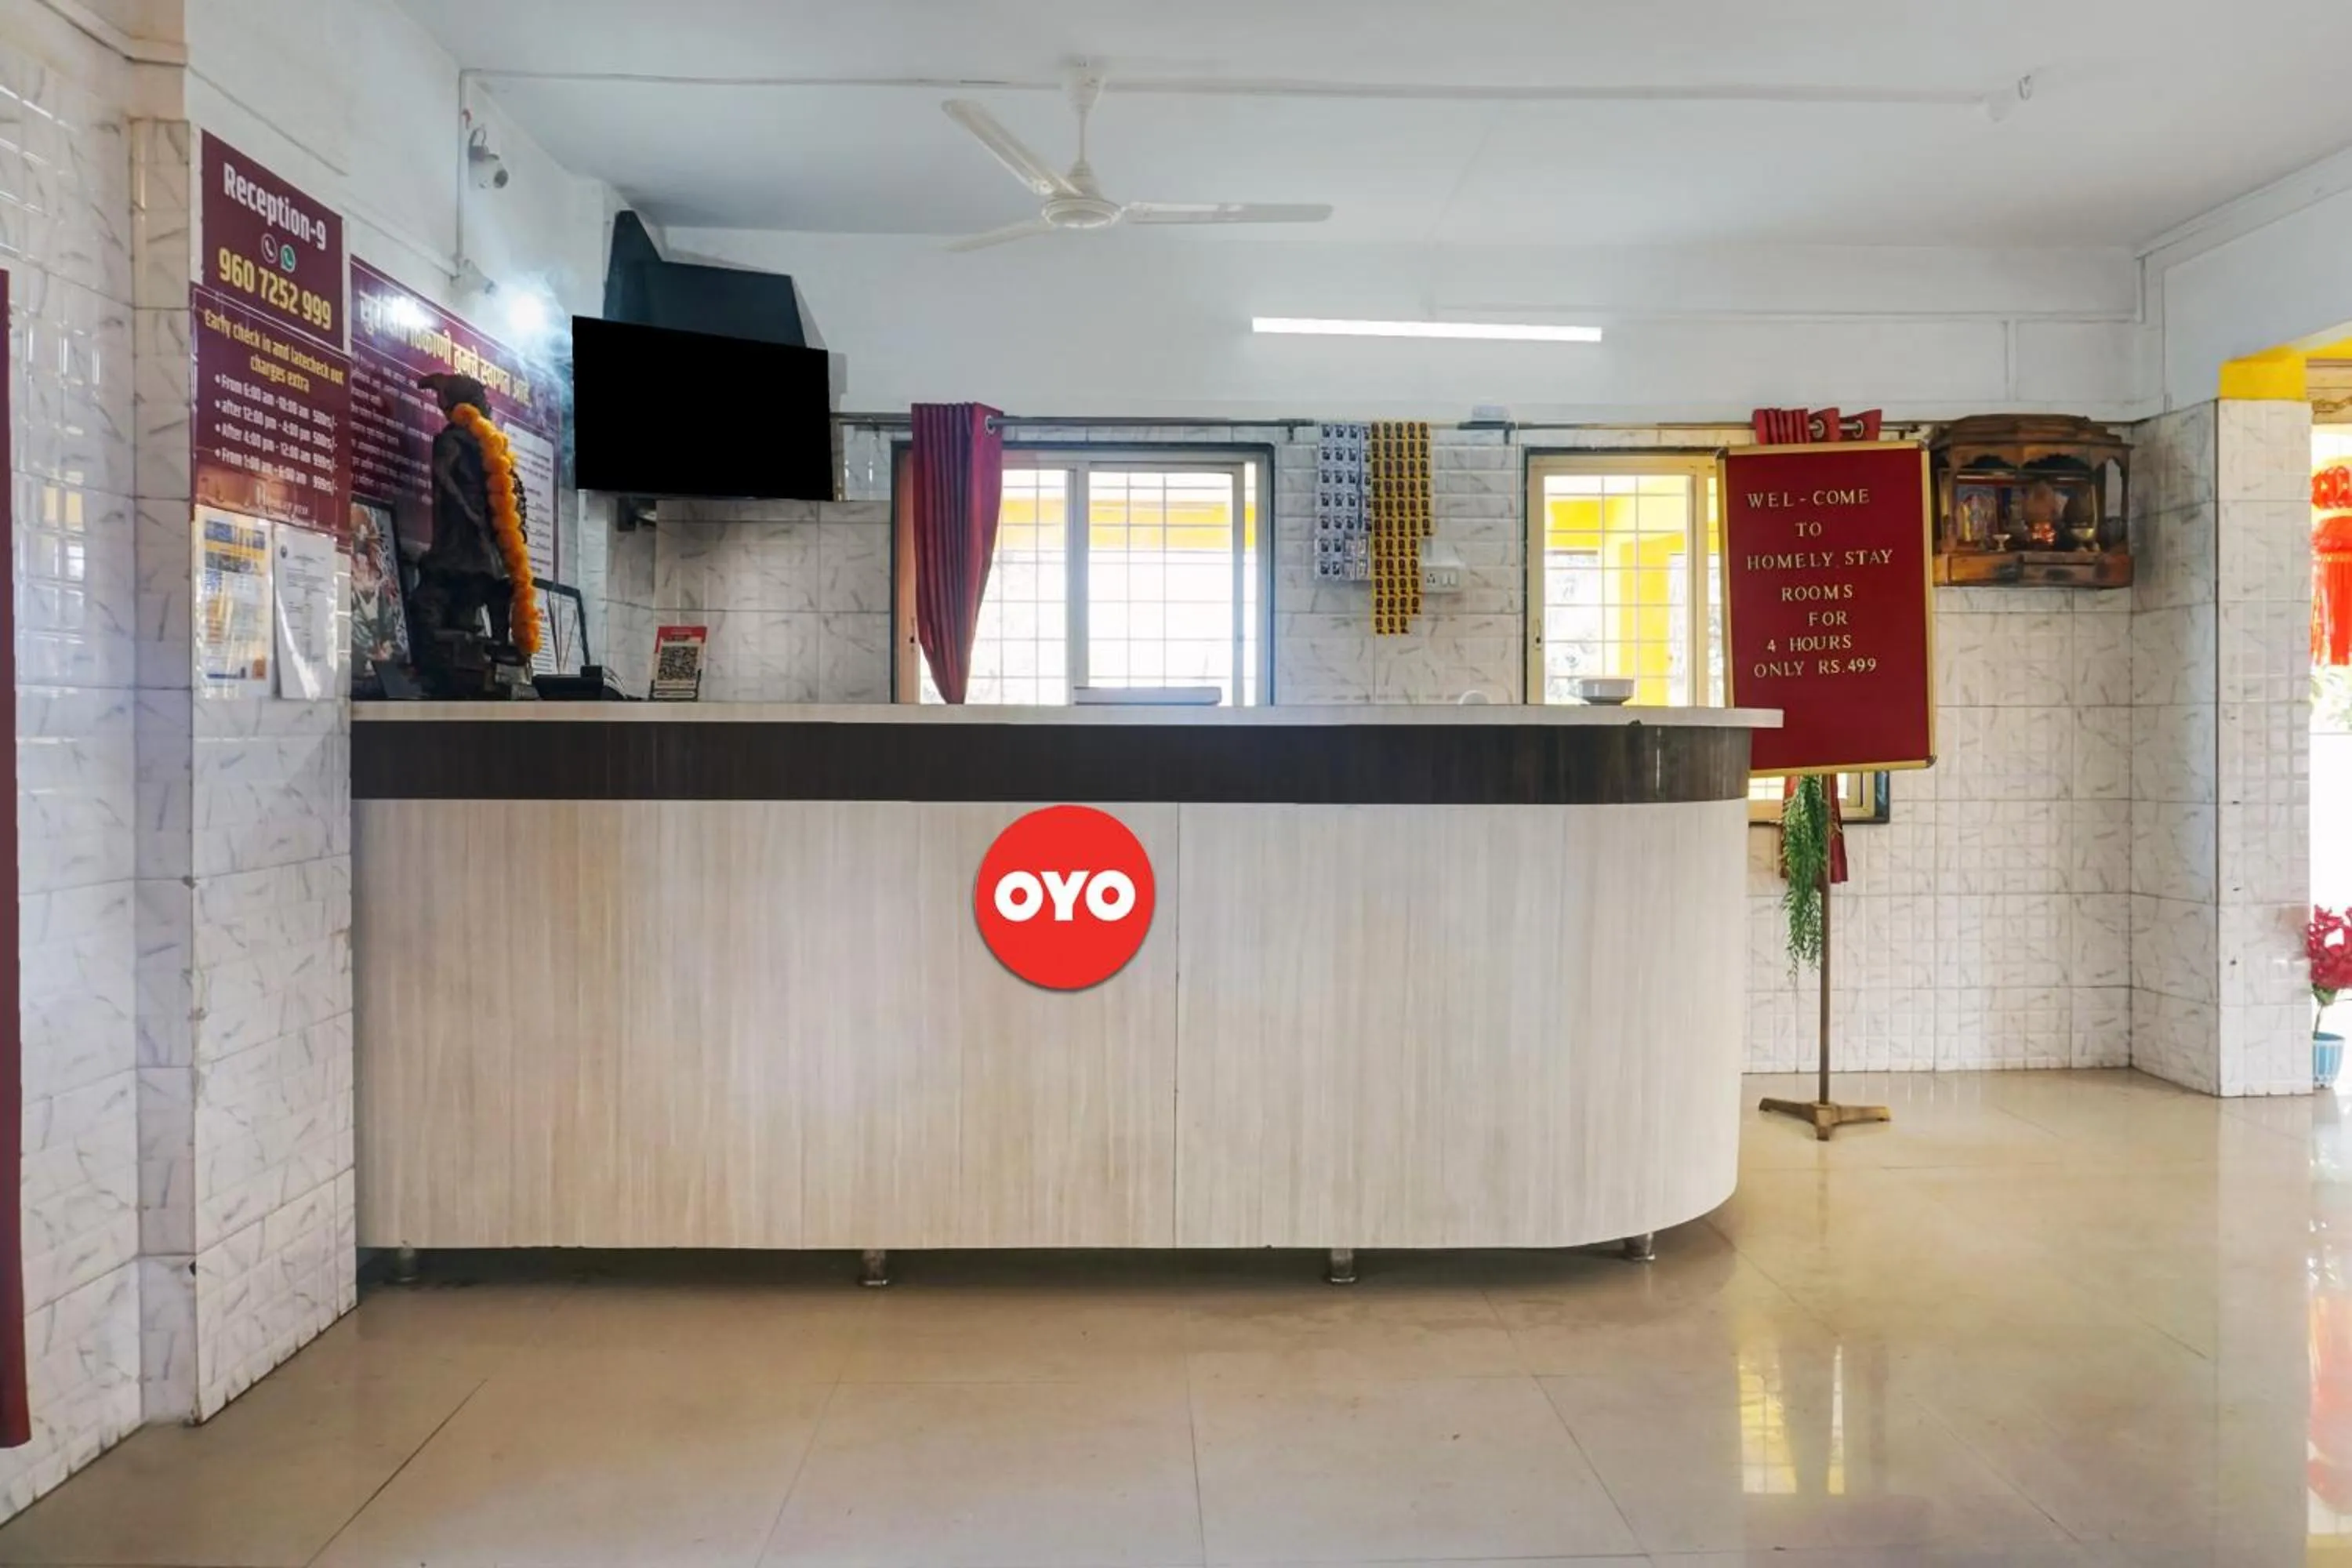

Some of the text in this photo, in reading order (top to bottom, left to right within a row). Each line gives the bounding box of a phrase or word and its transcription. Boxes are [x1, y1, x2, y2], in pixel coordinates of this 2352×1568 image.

[223, 162, 327, 251] Reception-9
[219, 246, 255, 294] 960
[258, 265, 299, 315] 7252
[302, 289, 332, 331] 999
[205, 309, 232, 339] Early
[234, 321, 260, 349] check
[262, 332, 272, 354] in
[273, 339, 290, 361] and
[331, 368, 345, 387] out
[221, 372, 242, 395] From
[250, 354, 310, 394] charges extra
[221, 446, 243, 467] From
[1795, 521, 1823, 538] TO
[1747, 549, 1893, 572] HOMELY STAY
[1781, 583, 1853, 602] ROOMS
[1808, 610, 1848, 627] FOR
[1766, 633, 1852, 653] 4 HOURS
[1753, 660, 1805, 678] ONLY
[993, 869, 1137, 923] OYO
